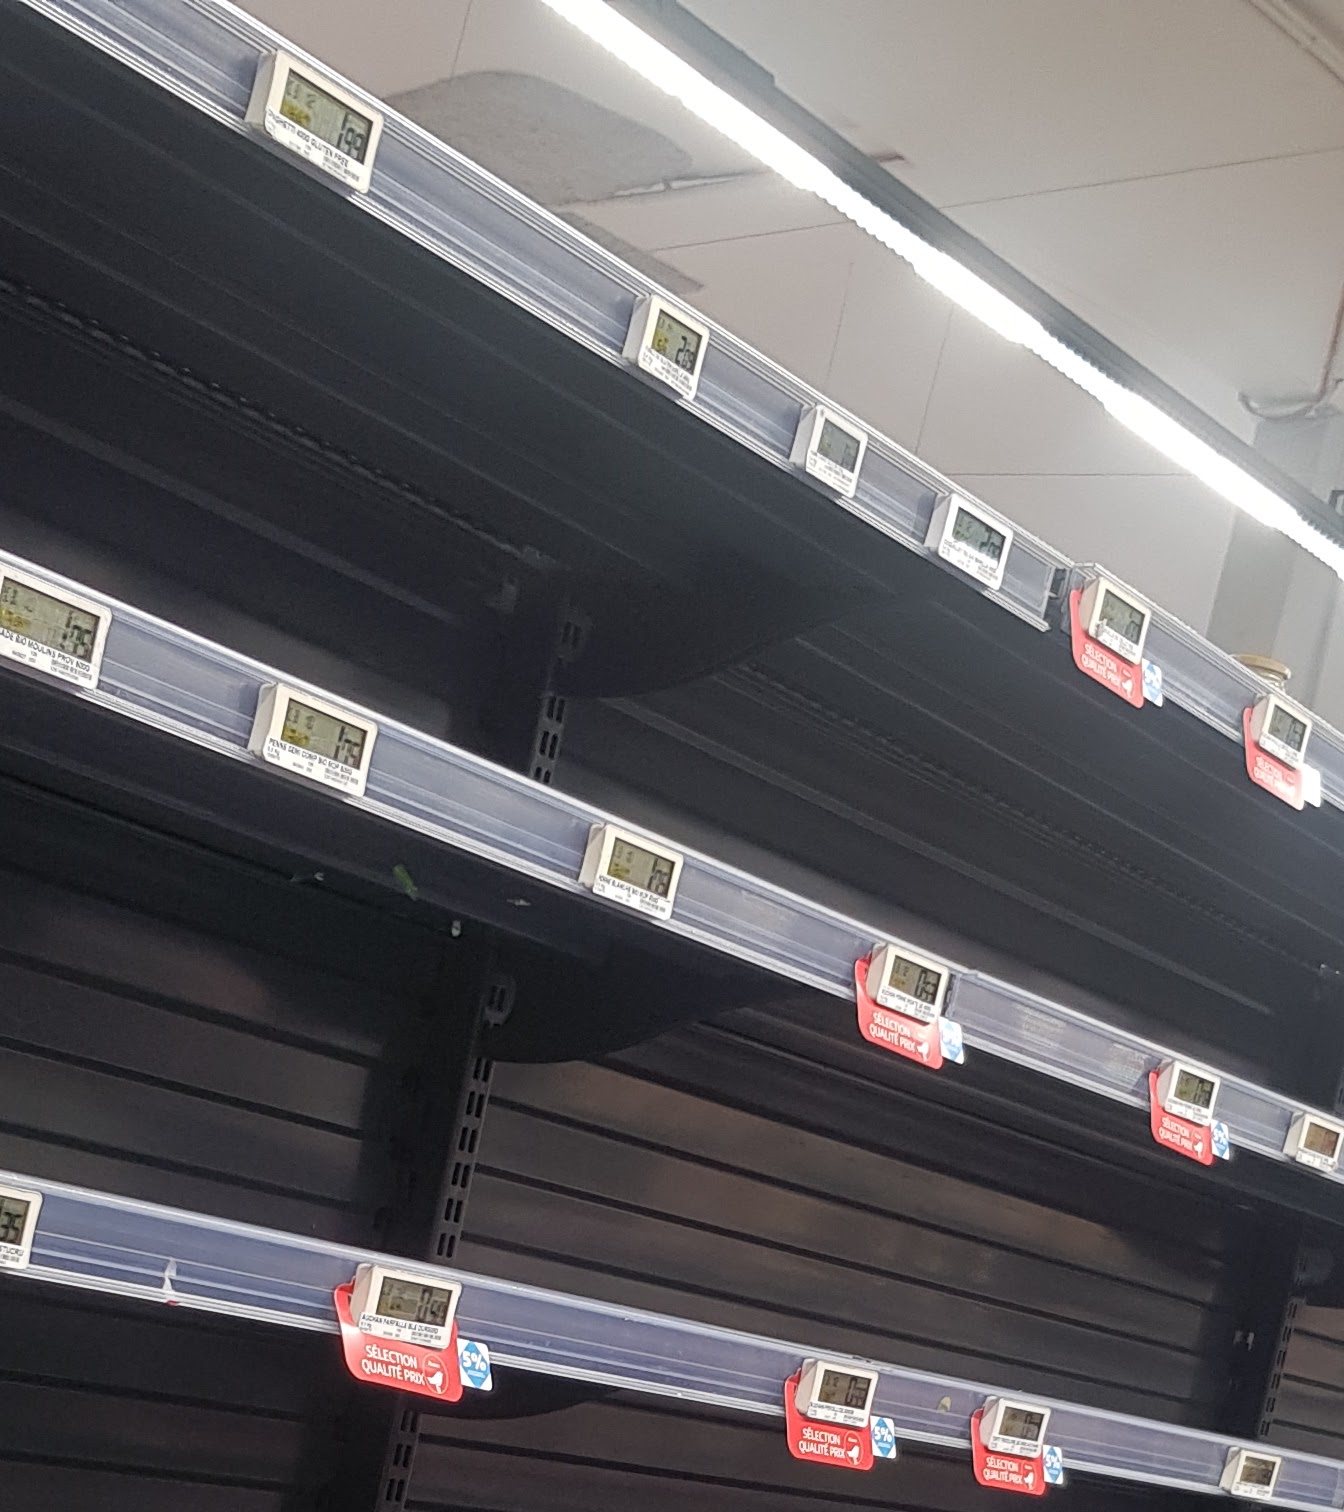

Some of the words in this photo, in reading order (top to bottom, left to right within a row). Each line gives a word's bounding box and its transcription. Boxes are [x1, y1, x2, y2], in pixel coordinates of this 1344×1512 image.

[366, 1344, 418, 1369] SÉLECTION
[462, 1352, 487, 1372] 5%
[361, 1359, 403, 1380] QUALITÉ
[404, 1370, 426, 1386] PRIX
[802, 1426, 840, 1445] SÉLECTION
[874, 1426, 892, 1442] 5%
[798, 1441, 829, 1456] QUALITÉ
[829, 1447, 846, 1459] PRIX
